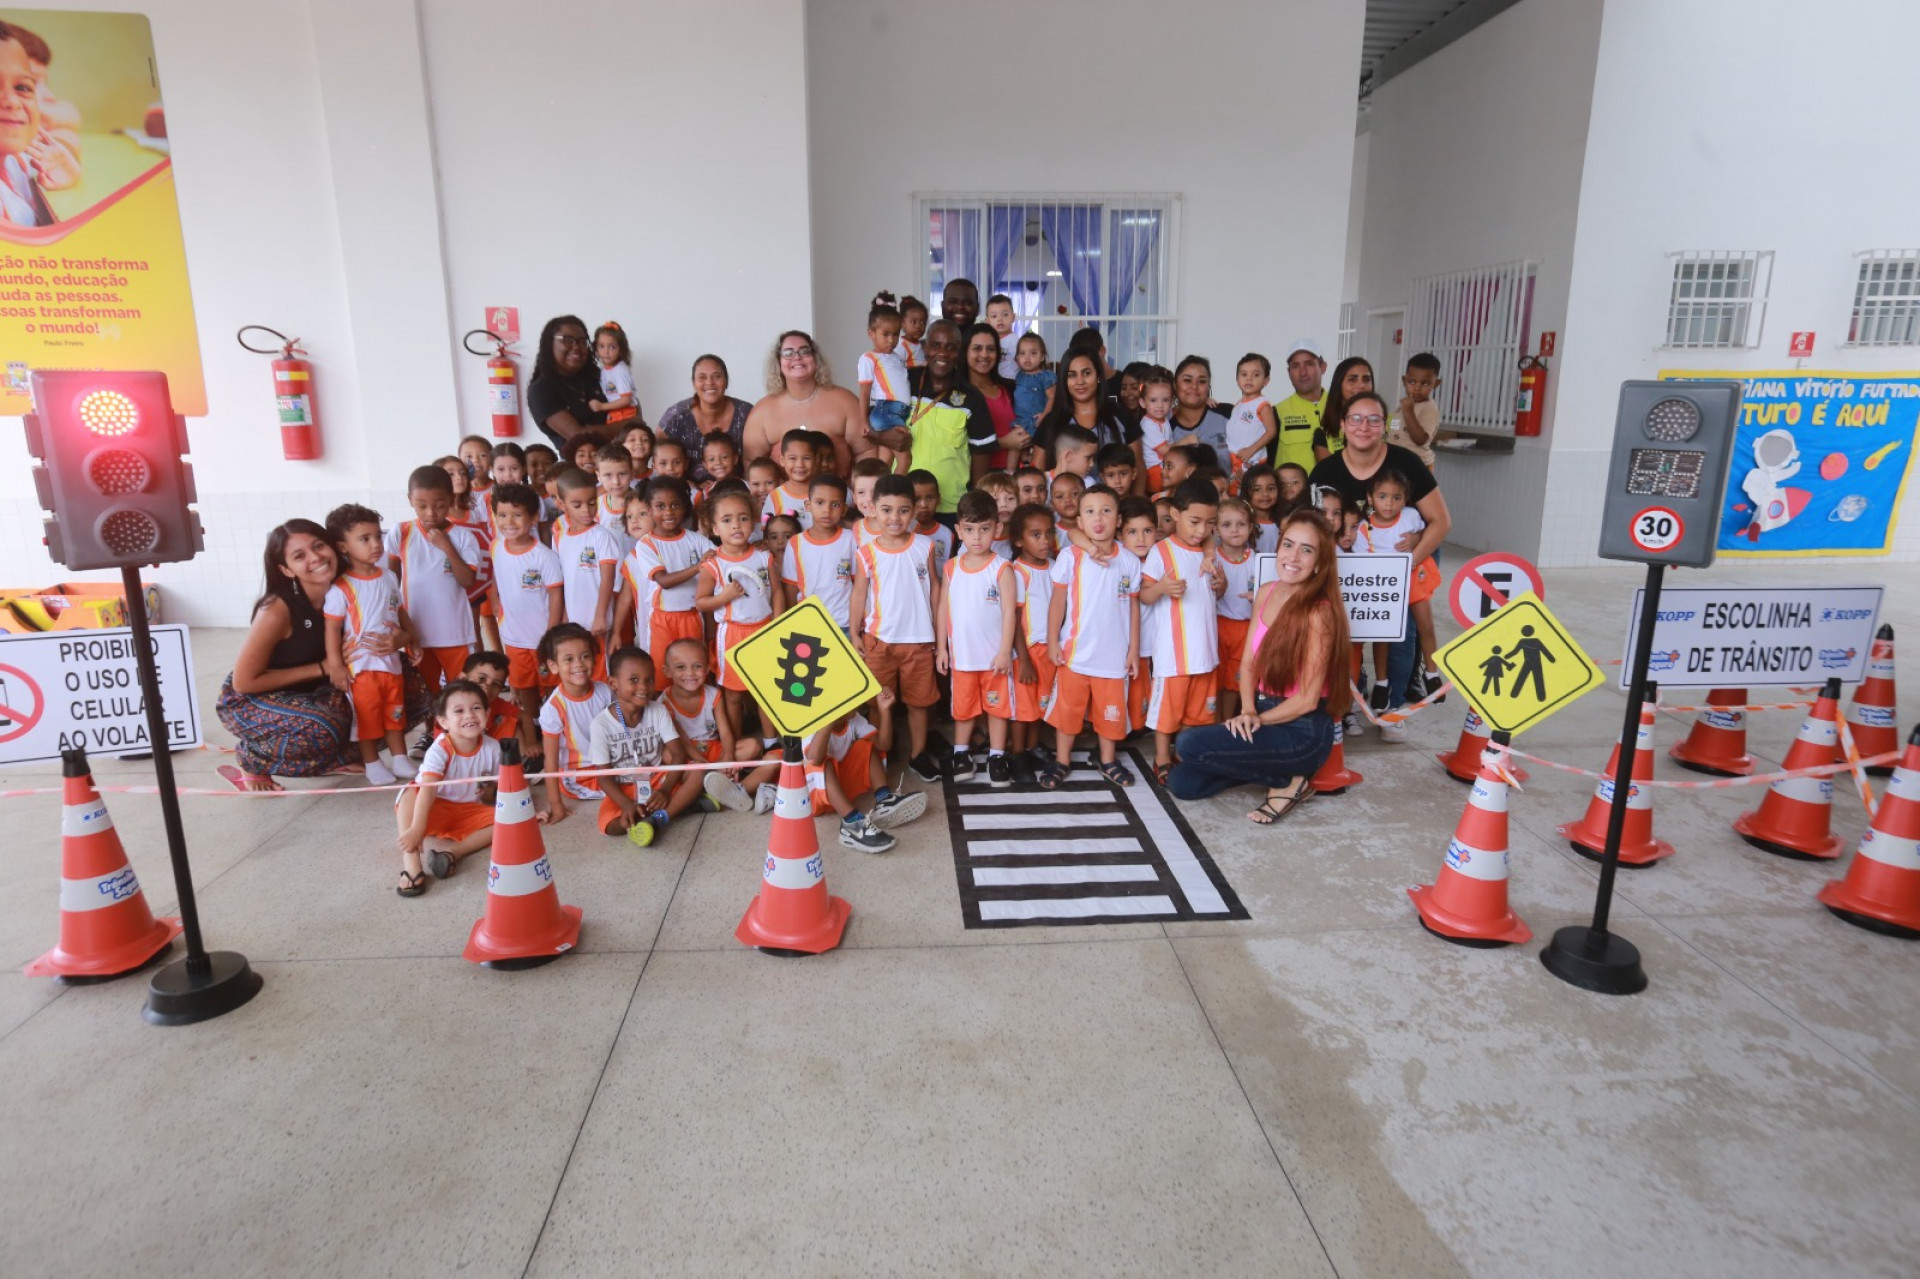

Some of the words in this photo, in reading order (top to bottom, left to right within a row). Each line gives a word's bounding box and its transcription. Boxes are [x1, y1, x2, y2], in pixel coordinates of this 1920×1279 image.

[28, 255, 58, 269] não
[61, 257, 149, 270] transforma
[0, 273, 49, 287] undo,
[53, 274, 128, 288] educação
[35, 292, 52, 301] as
[56, 292, 123, 304] pessoas.
[40, 306, 141, 318] transformam
[25, 323, 36, 333] o
[40, 322, 99, 333] mundo!
[1812, 399, 1830, 426] É
[1836, 398, 1890, 427] AQUI
[1640, 516, 1672, 537] 30
[1350, 607, 1391, 620] faixa
[1656, 611, 1695, 621] KOPP
[1703, 602, 1811, 629] ESCOLINHA
[1687, 647, 1715, 672] DE
[1721, 639, 1813, 672] TRÂNSITO
[65, 672, 80, 691] O
[87, 668, 130, 690] USO
[71, 694, 166, 720] CELULA
[58, 730, 86, 751] AO
[92, 720, 186, 747] VOLATE
